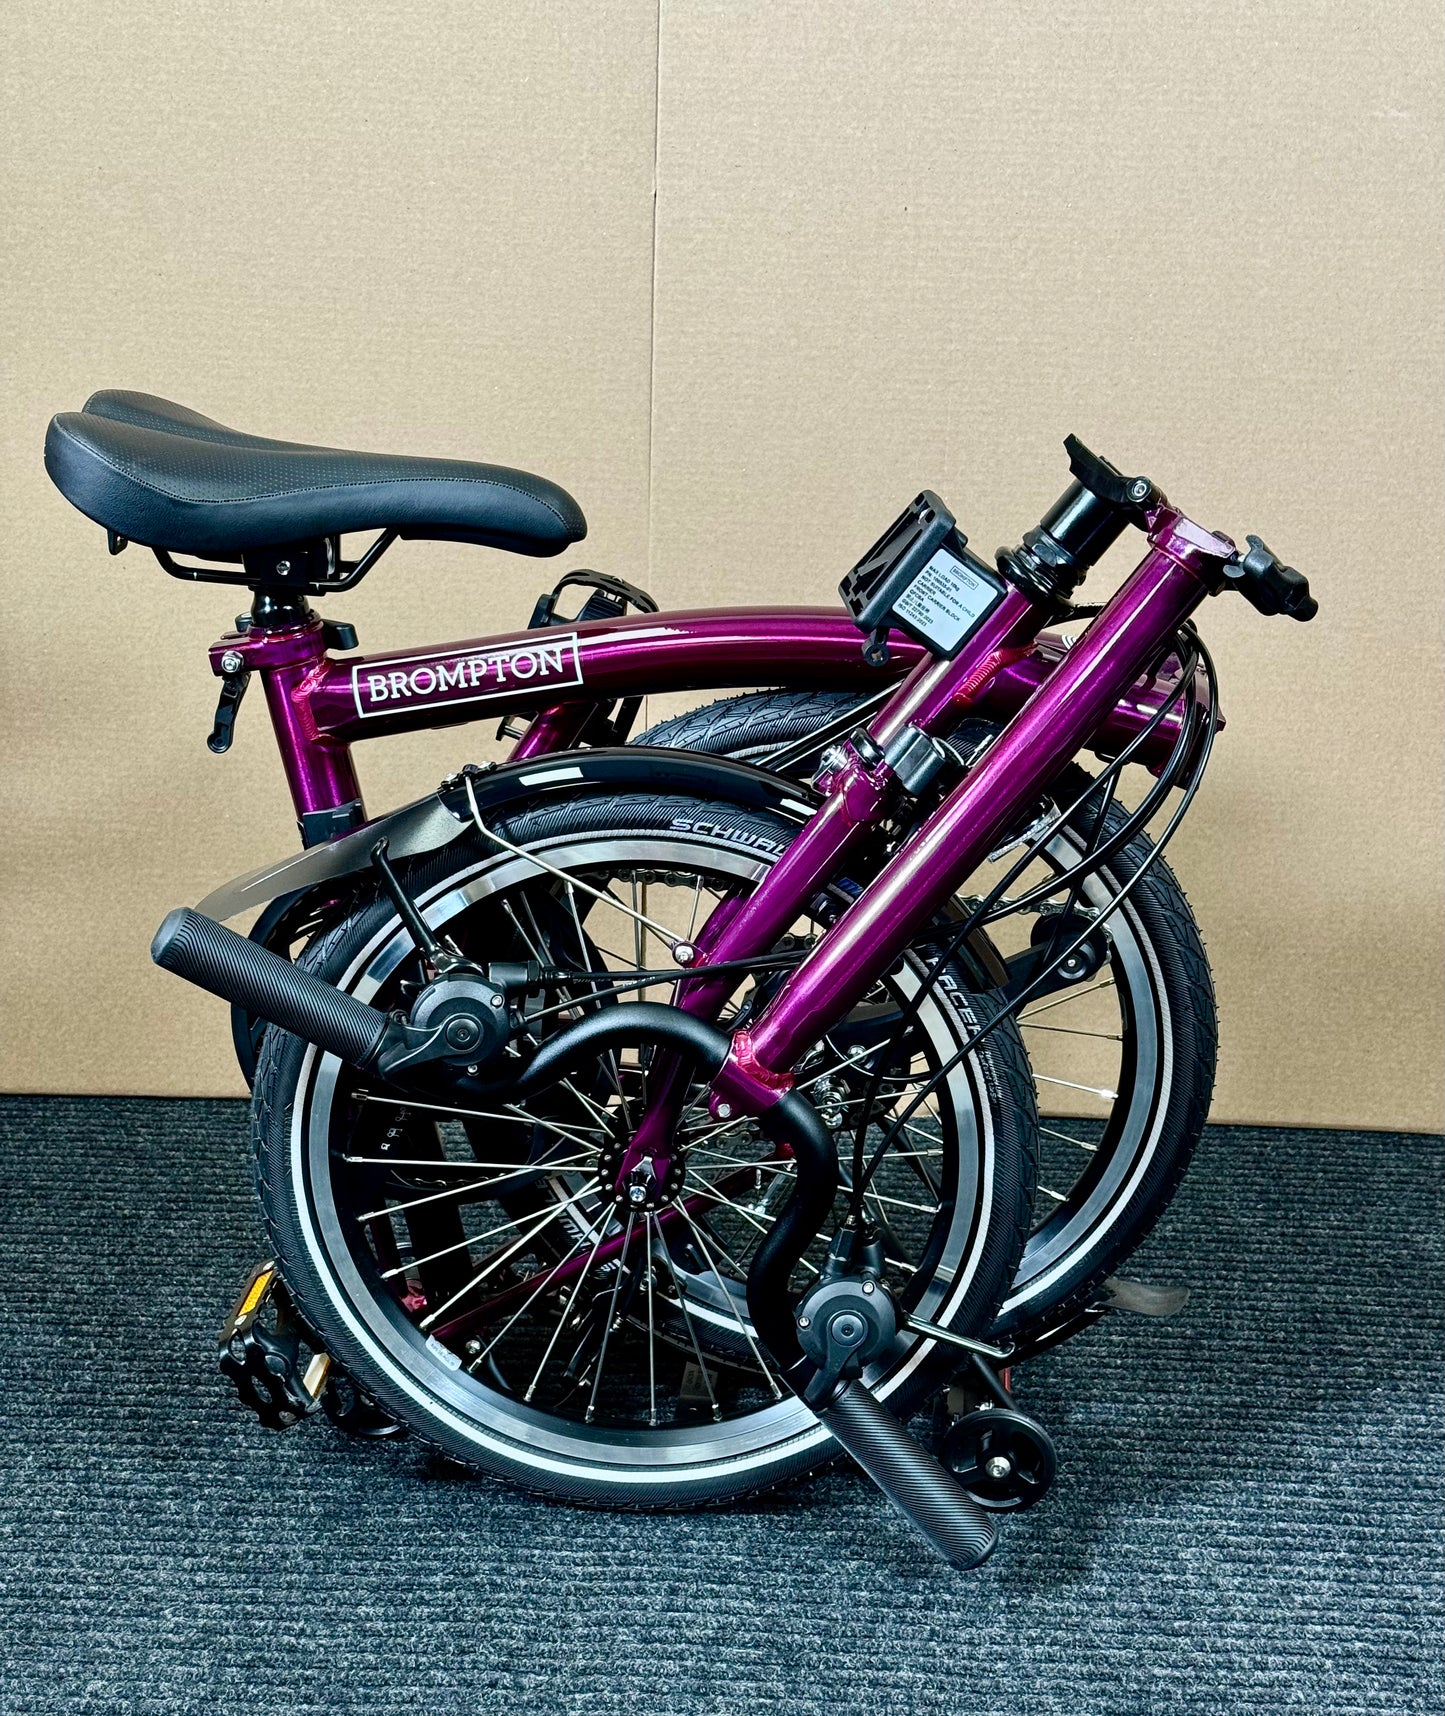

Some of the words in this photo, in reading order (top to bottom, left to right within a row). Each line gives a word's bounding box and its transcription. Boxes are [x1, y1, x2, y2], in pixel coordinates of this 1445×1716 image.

[917, 579, 936, 596] CARRIER
[928, 565, 939, 575] MAX
[939, 572, 951, 584] LOAD
[914, 584, 928, 597] FRONT
[927, 595, 946, 611] CARRIER
[945, 608, 961, 622] BLOCK
[921, 574, 930, 583] NOT
[929, 580, 951, 600] SUITABLE
[950, 596, 960, 606] FOR
[961, 606, 976, 618] CHILD
[367, 649, 565, 702] BROMPTON
